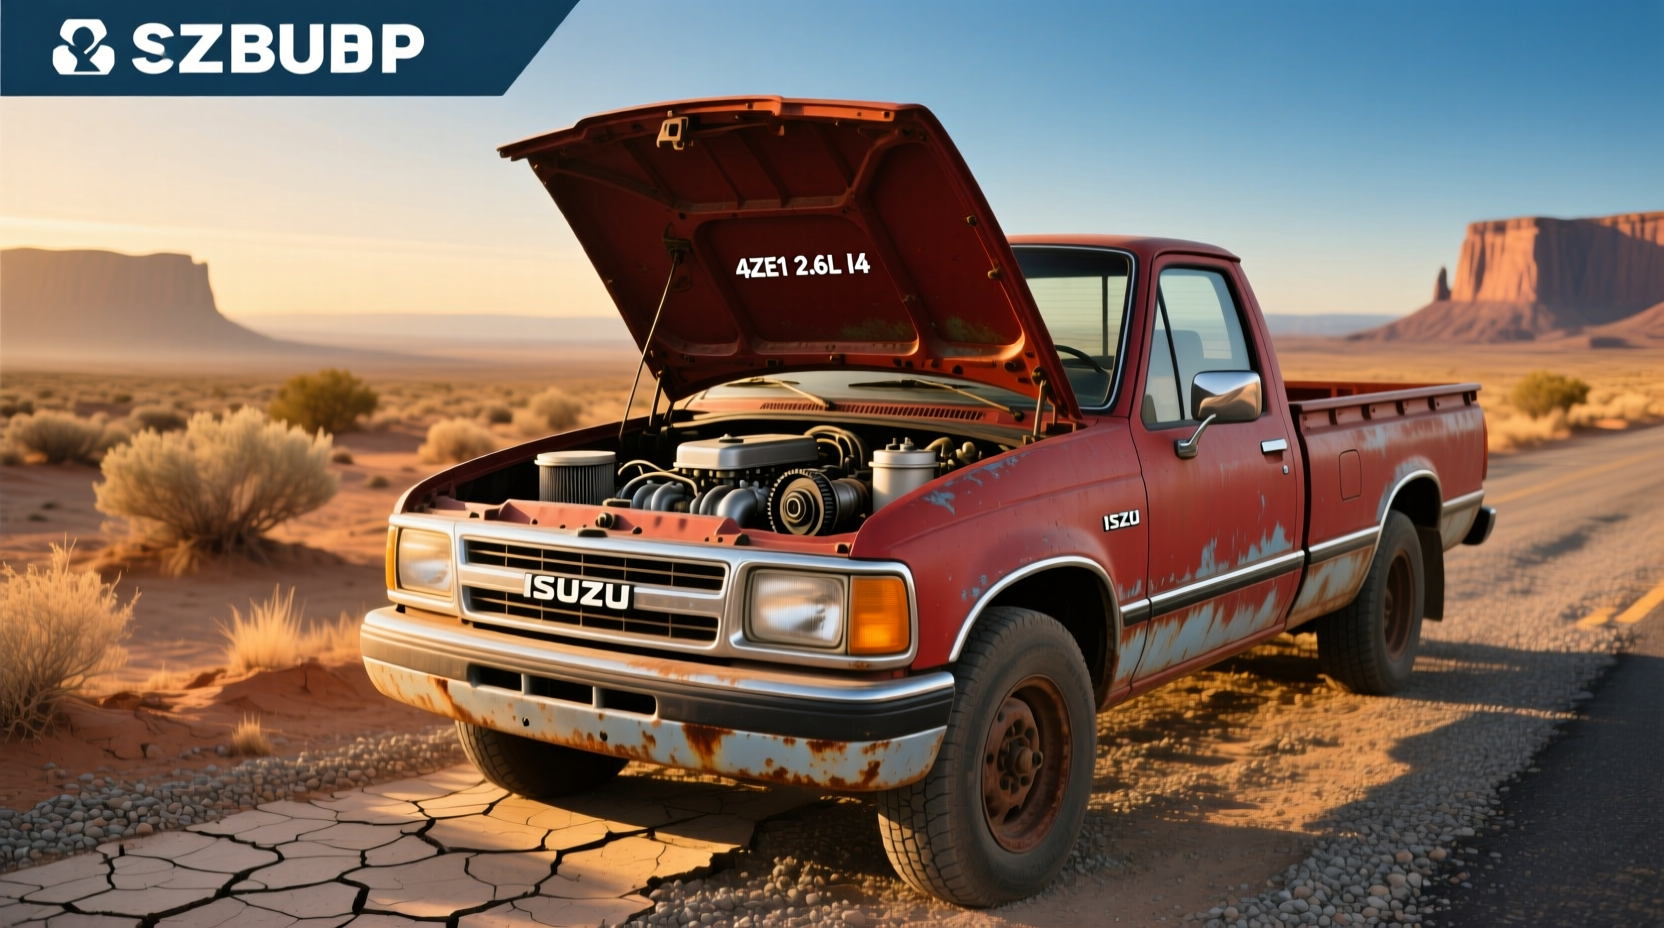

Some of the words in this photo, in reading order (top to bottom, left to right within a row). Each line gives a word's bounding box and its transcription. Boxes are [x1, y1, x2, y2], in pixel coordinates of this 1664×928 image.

[735, 255, 789, 279] 4ZE1
[793, 254, 842, 276] 2.6L
[523, 573, 630, 610] ISUZU
